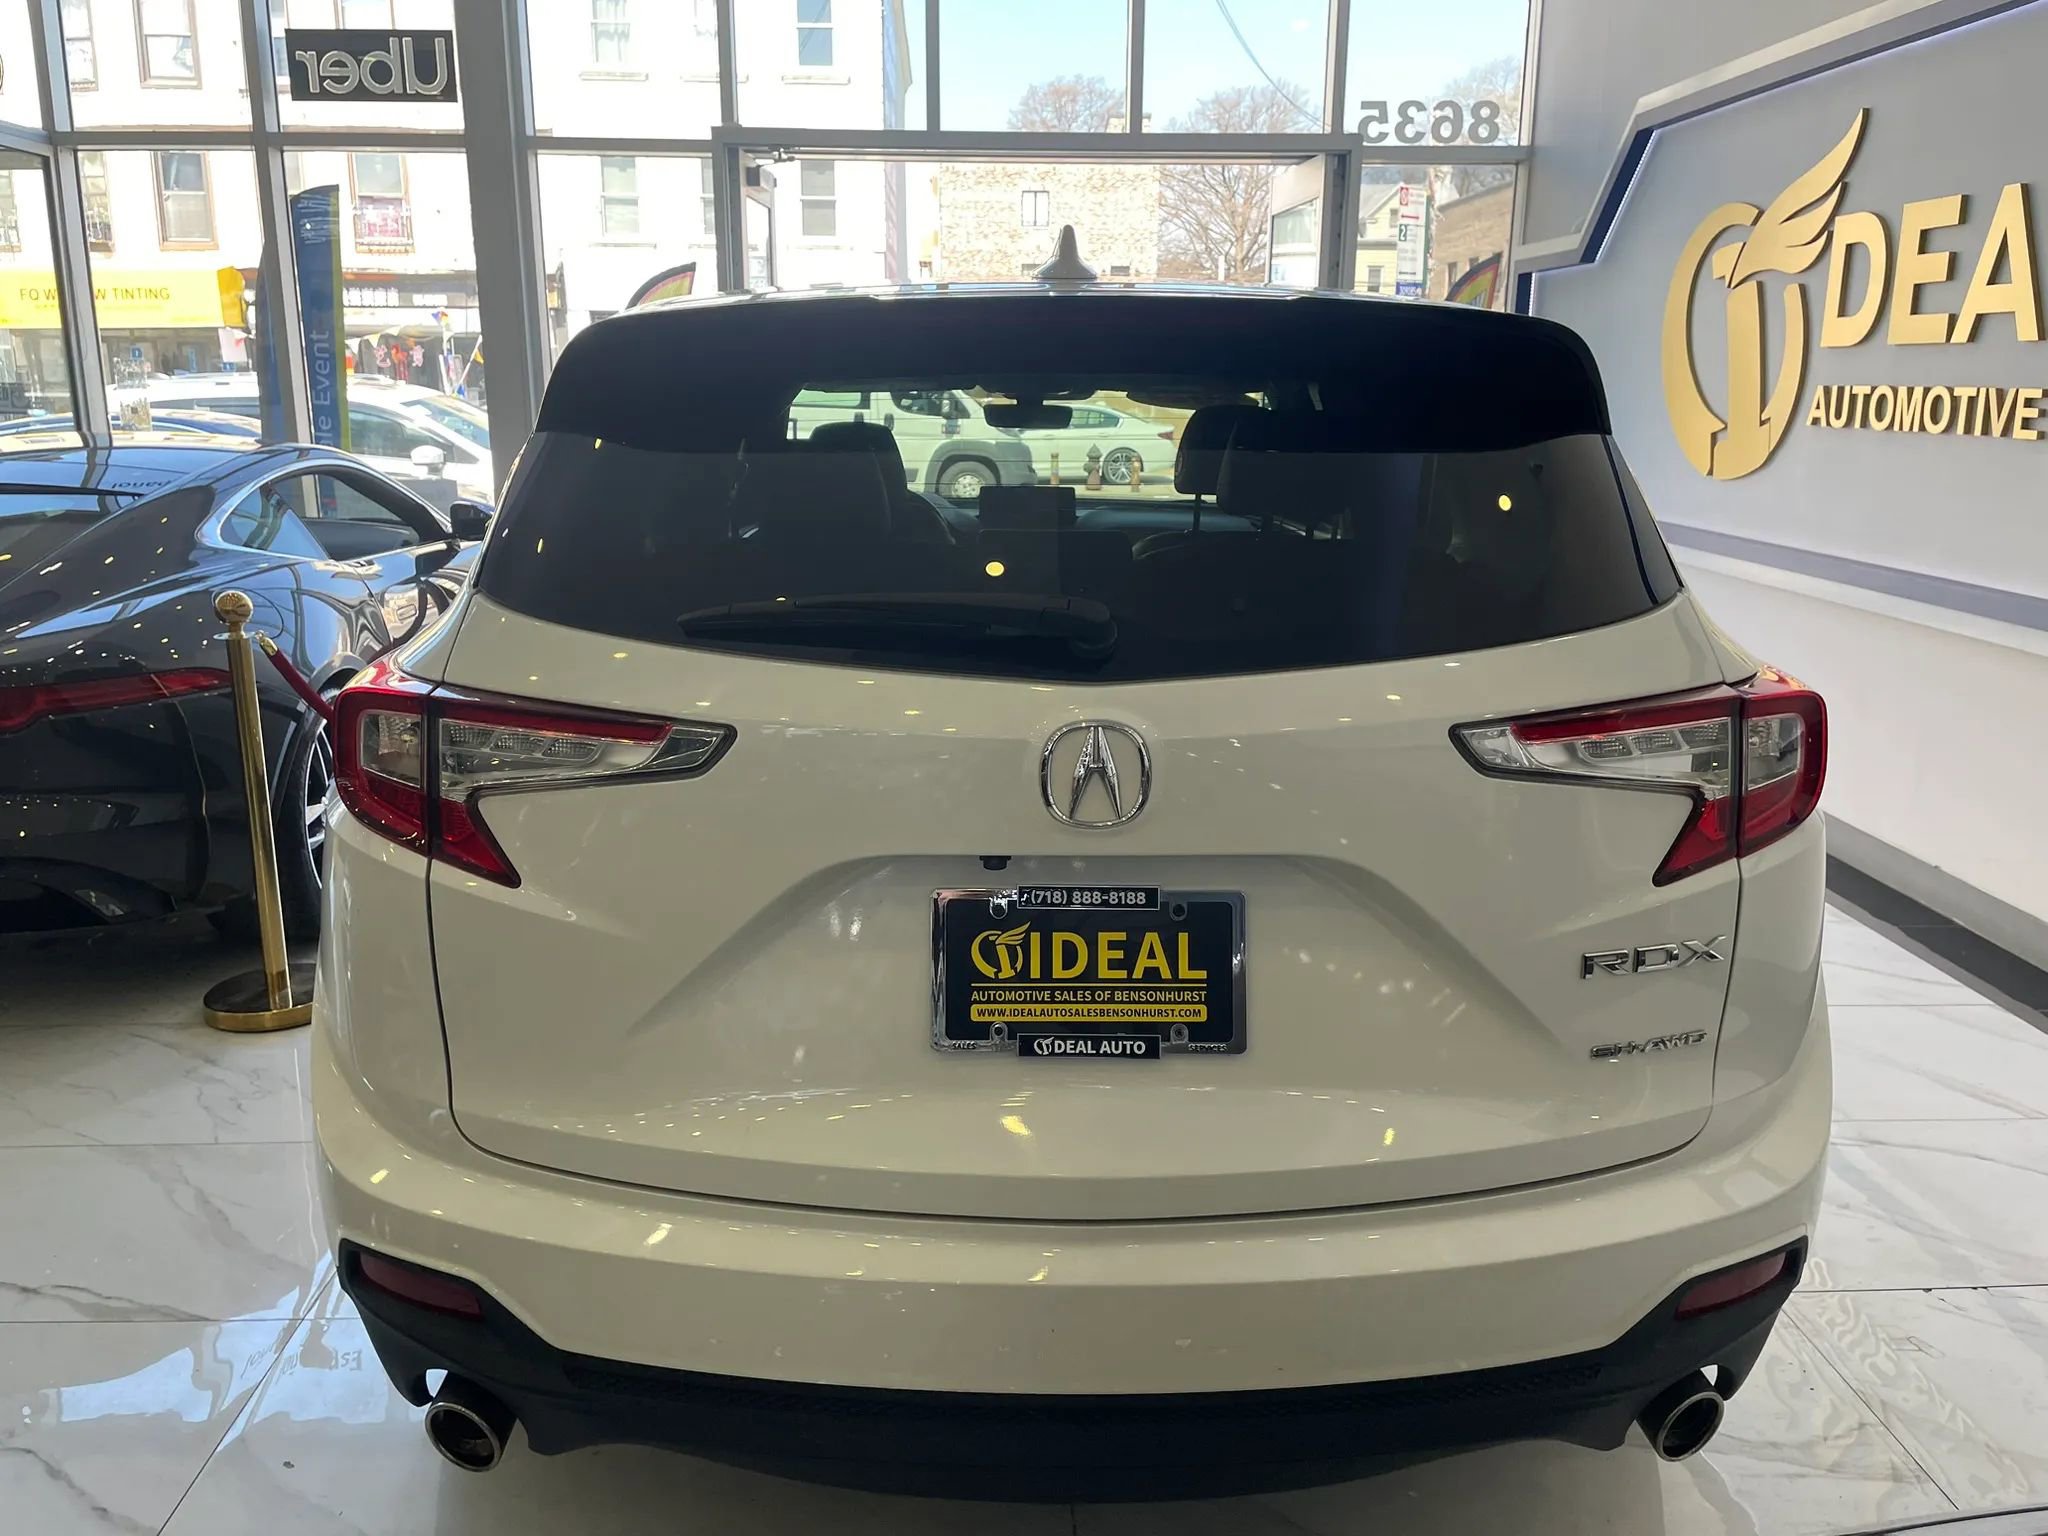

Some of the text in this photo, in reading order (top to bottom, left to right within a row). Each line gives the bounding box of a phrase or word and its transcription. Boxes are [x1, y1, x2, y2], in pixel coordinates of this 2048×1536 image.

[112, 287, 170, 300] TINTING
[310, 329, 331, 405] Event
[1806, 384, 2044, 440] AUTOMOTIVE
[1031, 889, 1146, 904] (718) 888-8188
[1030, 931, 1208, 979] IDEAL
[1581, 934, 1728, 979] RDX
[971, 990, 1207, 1002] AUTOMOTIVE SALES OF BENSONHURST
[977, 1008, 1202, 1018] WWW.IDEALAUTOSALESBENSONHURST.COM
[1099, 1040, 1146, 1055] AUTO
